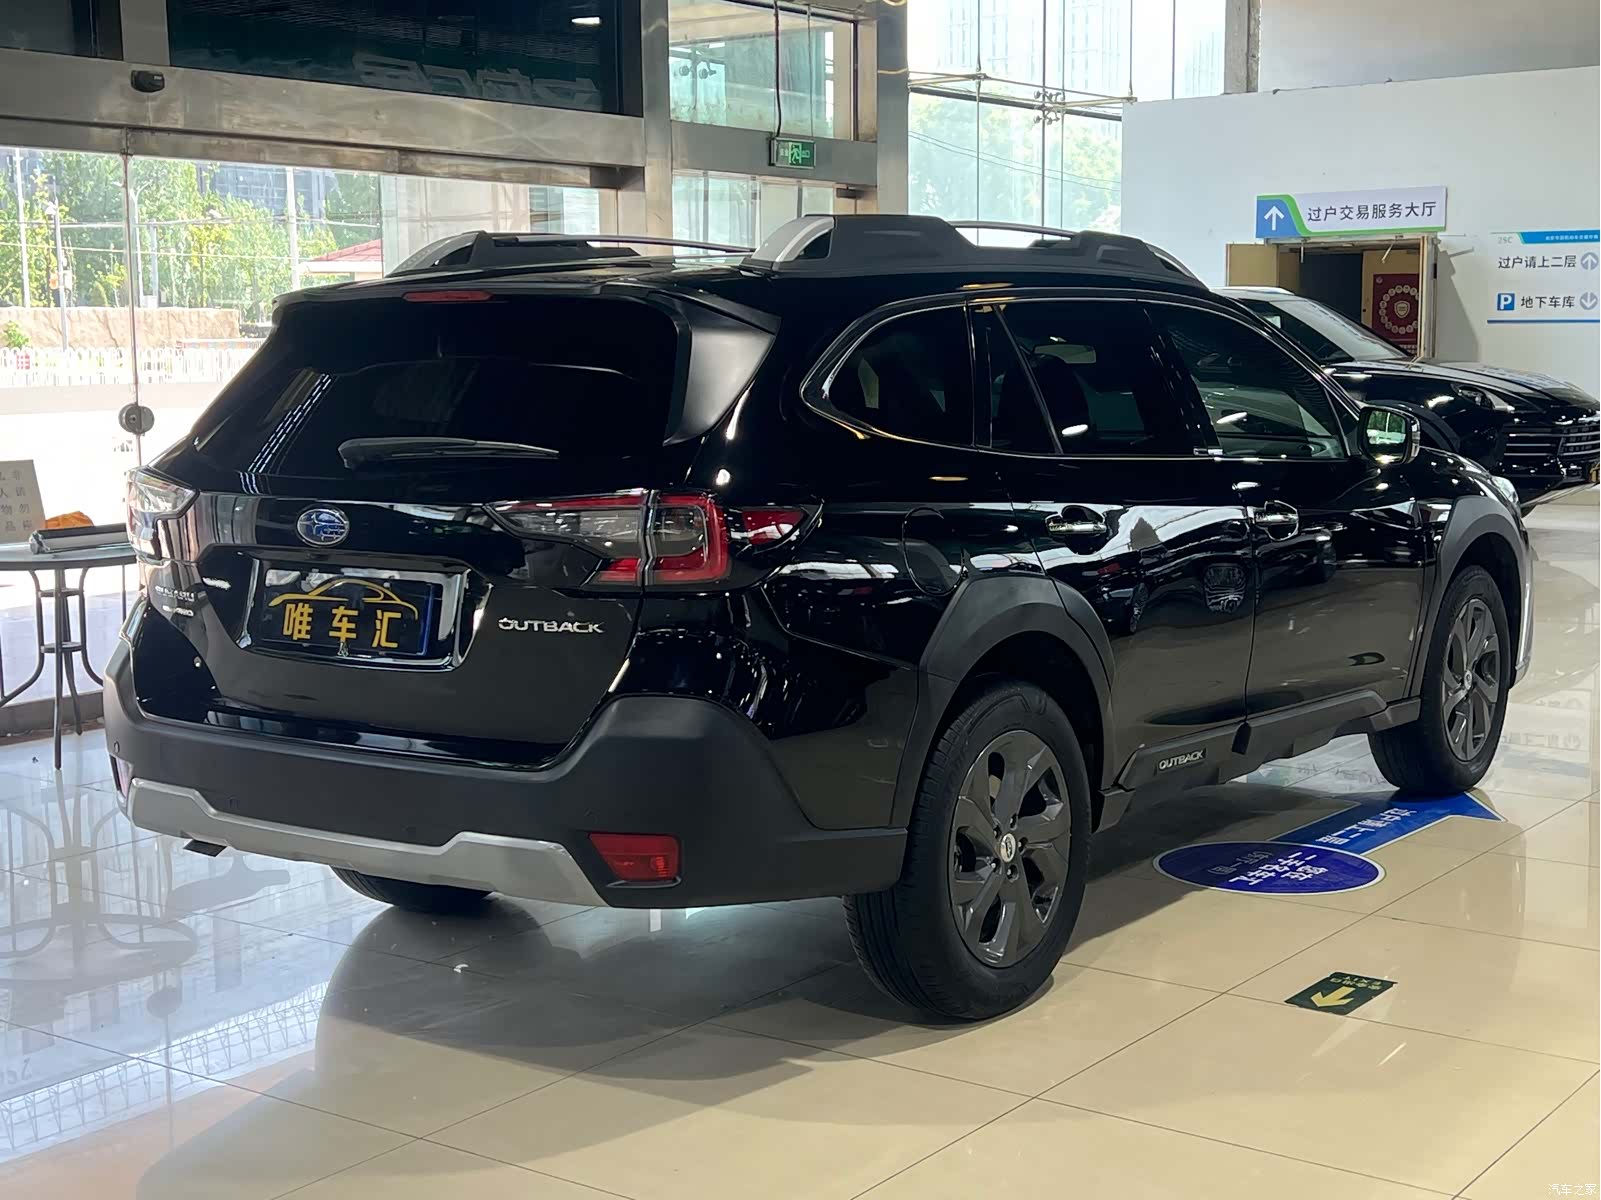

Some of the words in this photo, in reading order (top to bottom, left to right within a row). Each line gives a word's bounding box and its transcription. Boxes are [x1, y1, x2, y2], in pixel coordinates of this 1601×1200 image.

[1307, 201, 1437, 221] 过户交易服务大厅
[1497, 255, 1577, 269] 过户请上二层
[1499, 293, 1513, 310] P
[1520, 295, 1575, 309] 地下车库
[282, 602, 402, 648] 唯车汇
[498, 617, 605, 633] OUTBACK
[1159, 750, 1204, 769] OUTBACK
